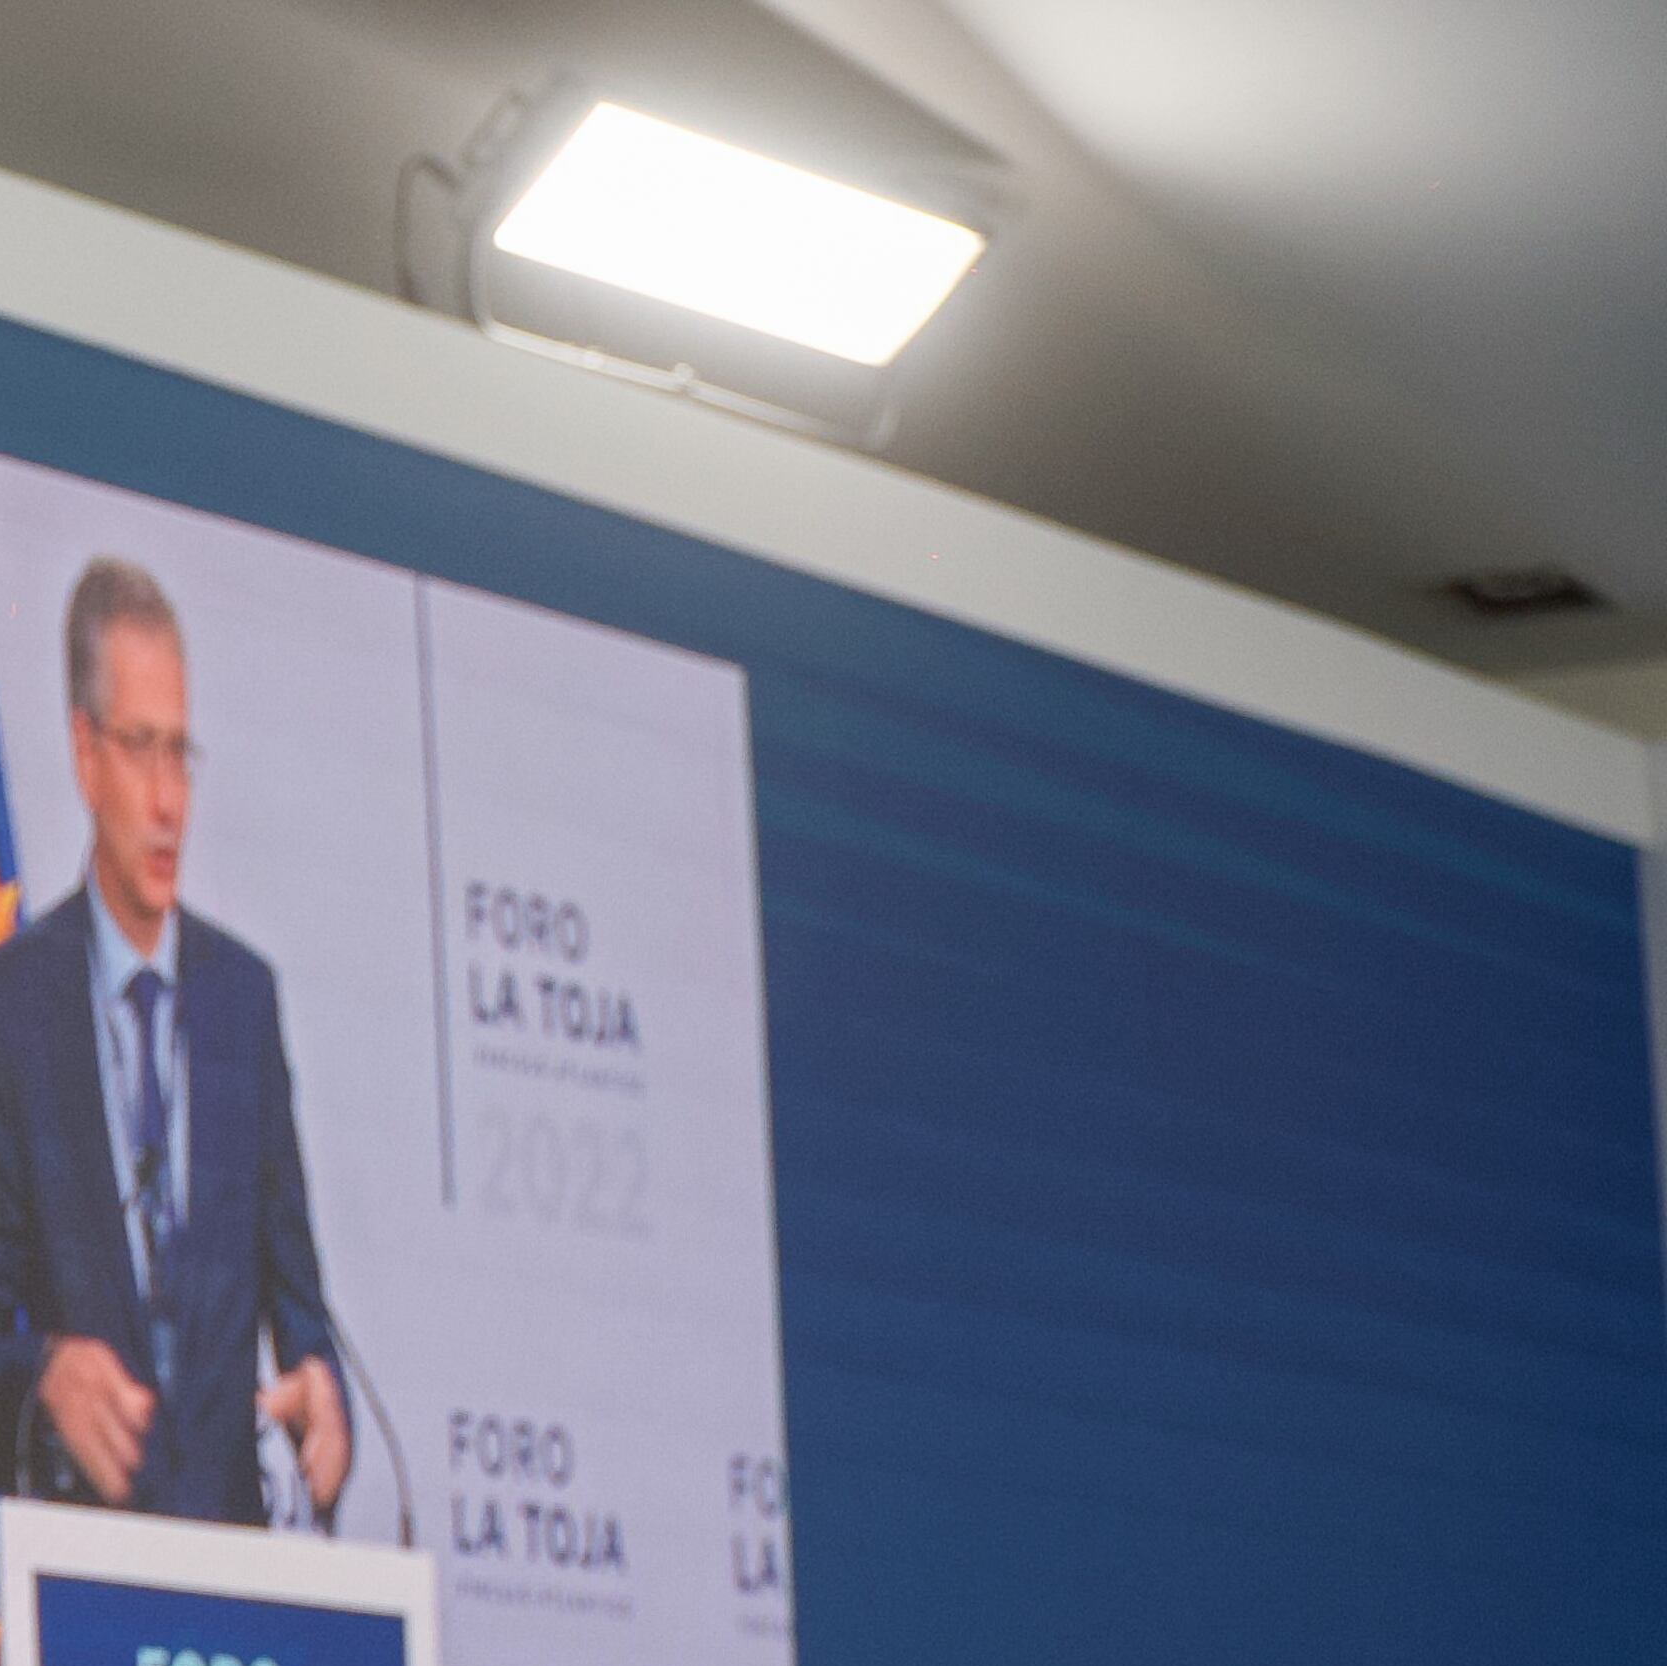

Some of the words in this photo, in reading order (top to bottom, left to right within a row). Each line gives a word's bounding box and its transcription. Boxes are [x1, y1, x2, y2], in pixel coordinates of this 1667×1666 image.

[466, 880, 592, 965] FORO
[468, 960, 524, 1030] LA
[535, 972, 642, 1050] TOJA
[450, 1410, 572, 1487] FORO
[451, 1494, 506, 1558] LA
[522, 1501, 624, 1570] TOJA
